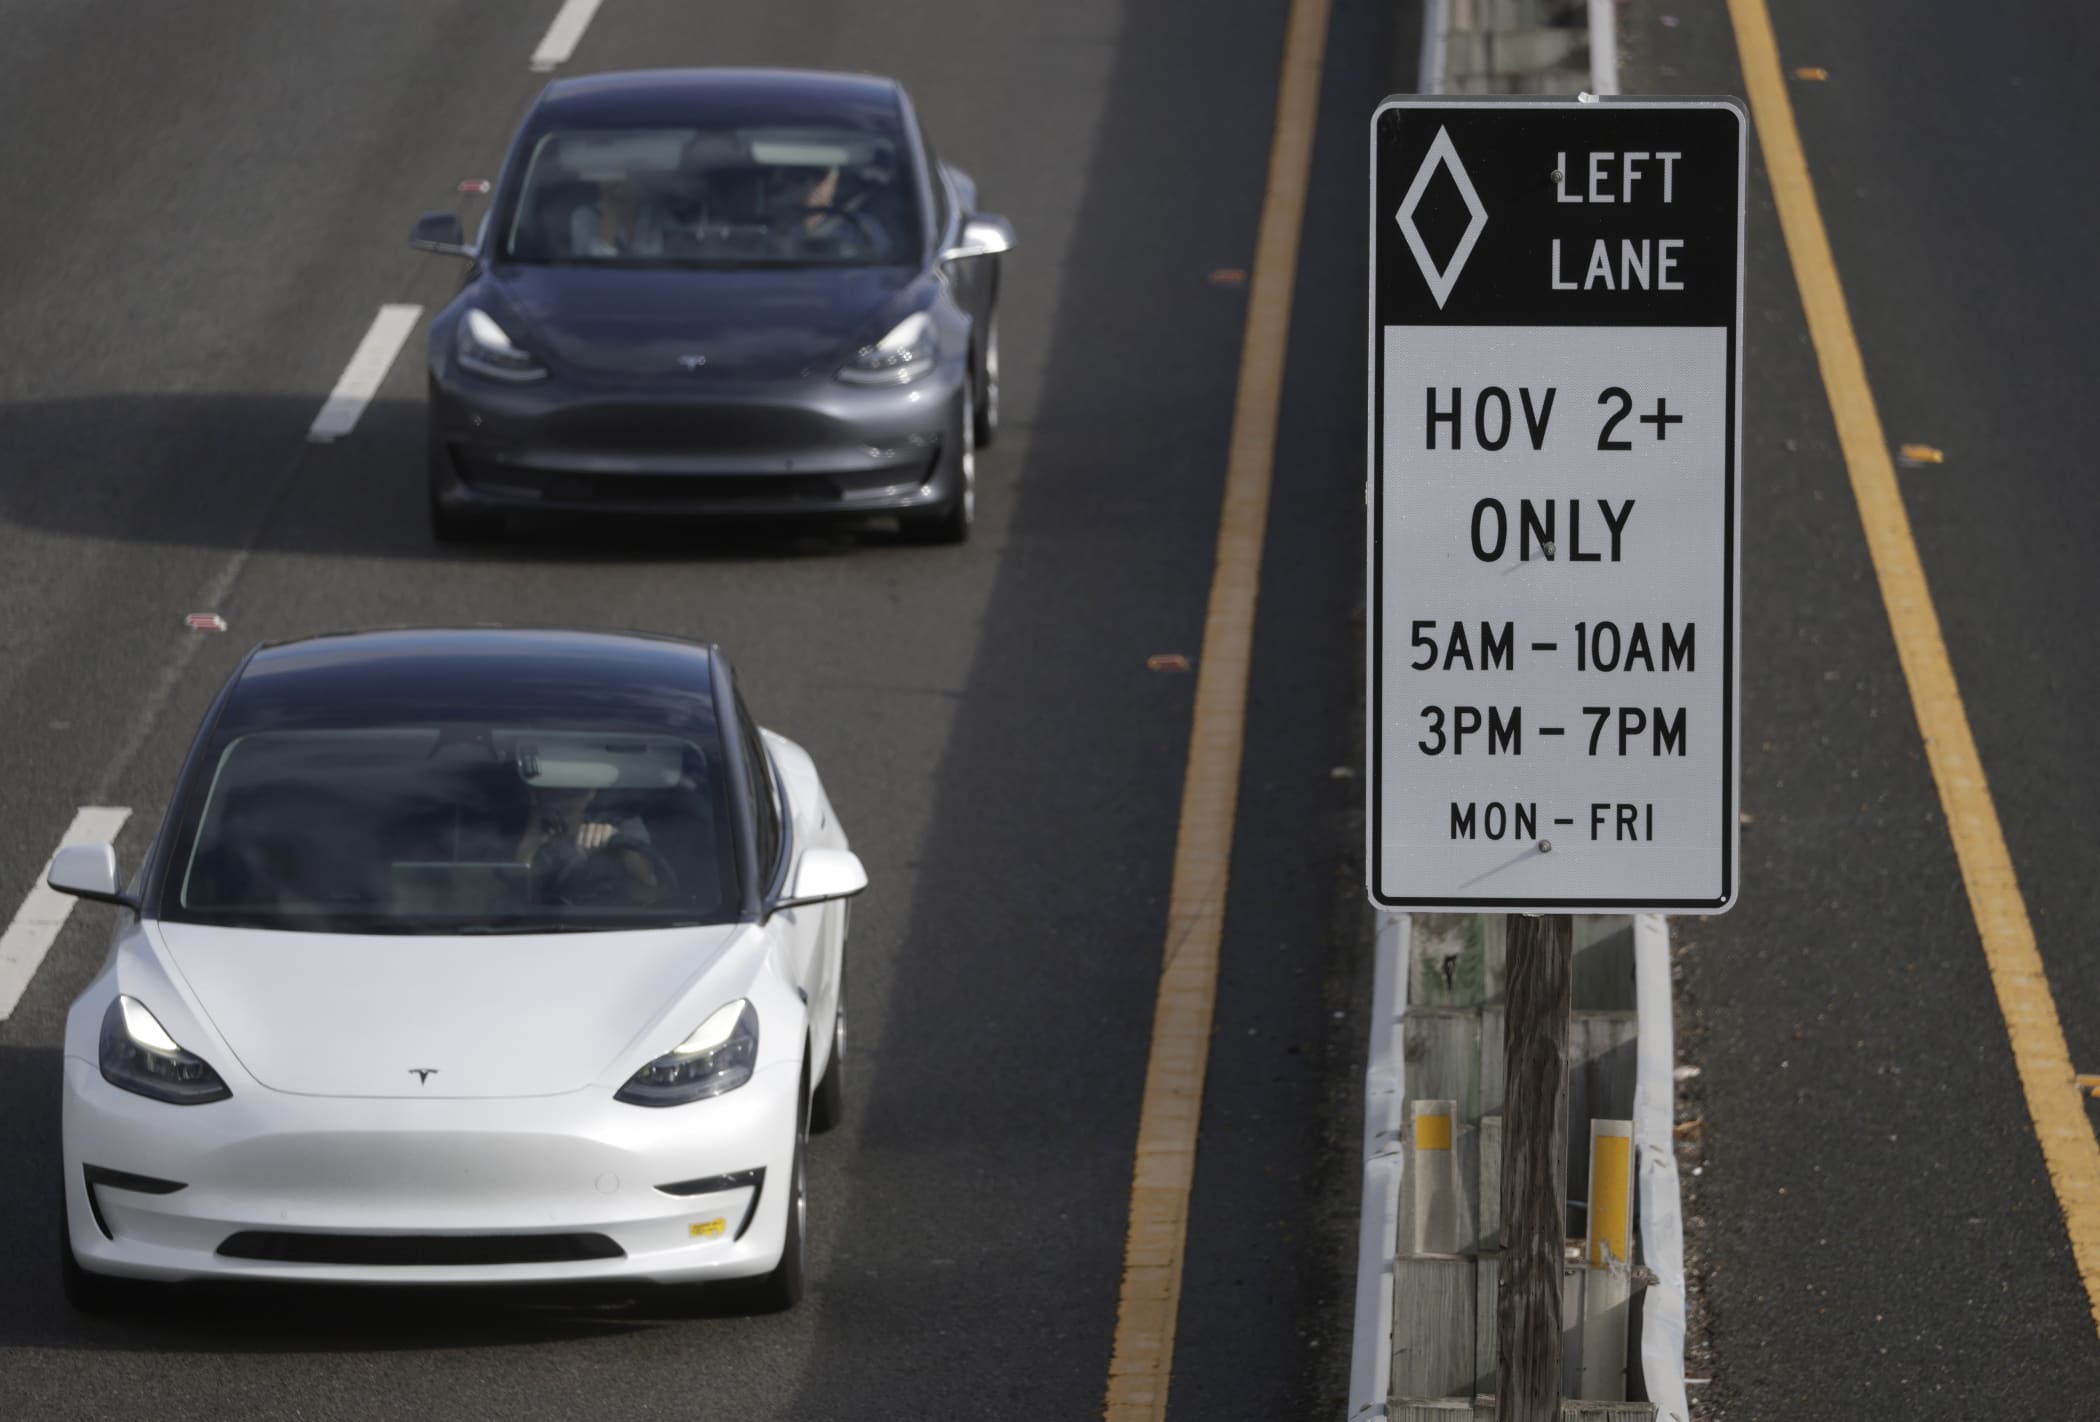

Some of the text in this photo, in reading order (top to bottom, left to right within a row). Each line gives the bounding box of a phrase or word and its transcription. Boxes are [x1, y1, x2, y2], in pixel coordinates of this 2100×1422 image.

[1554, 152, 1681, 202] LEFT
[1552, 239, 1683, 290] LANE
[1427, 387, 1682, 451] HOV 2+
[1471, 498, 1635, 562] ONLY
[1412, 621, 1513, 670] 5AM
[1575, 621, 1695, 672] 10AM
[1419, 706, 1521, 755] 3PM
[1583, 707, 1686, 756] 7PM
[1451, 802, 1536, 840] MON
[1592, 804, 1652, 840] FRI
